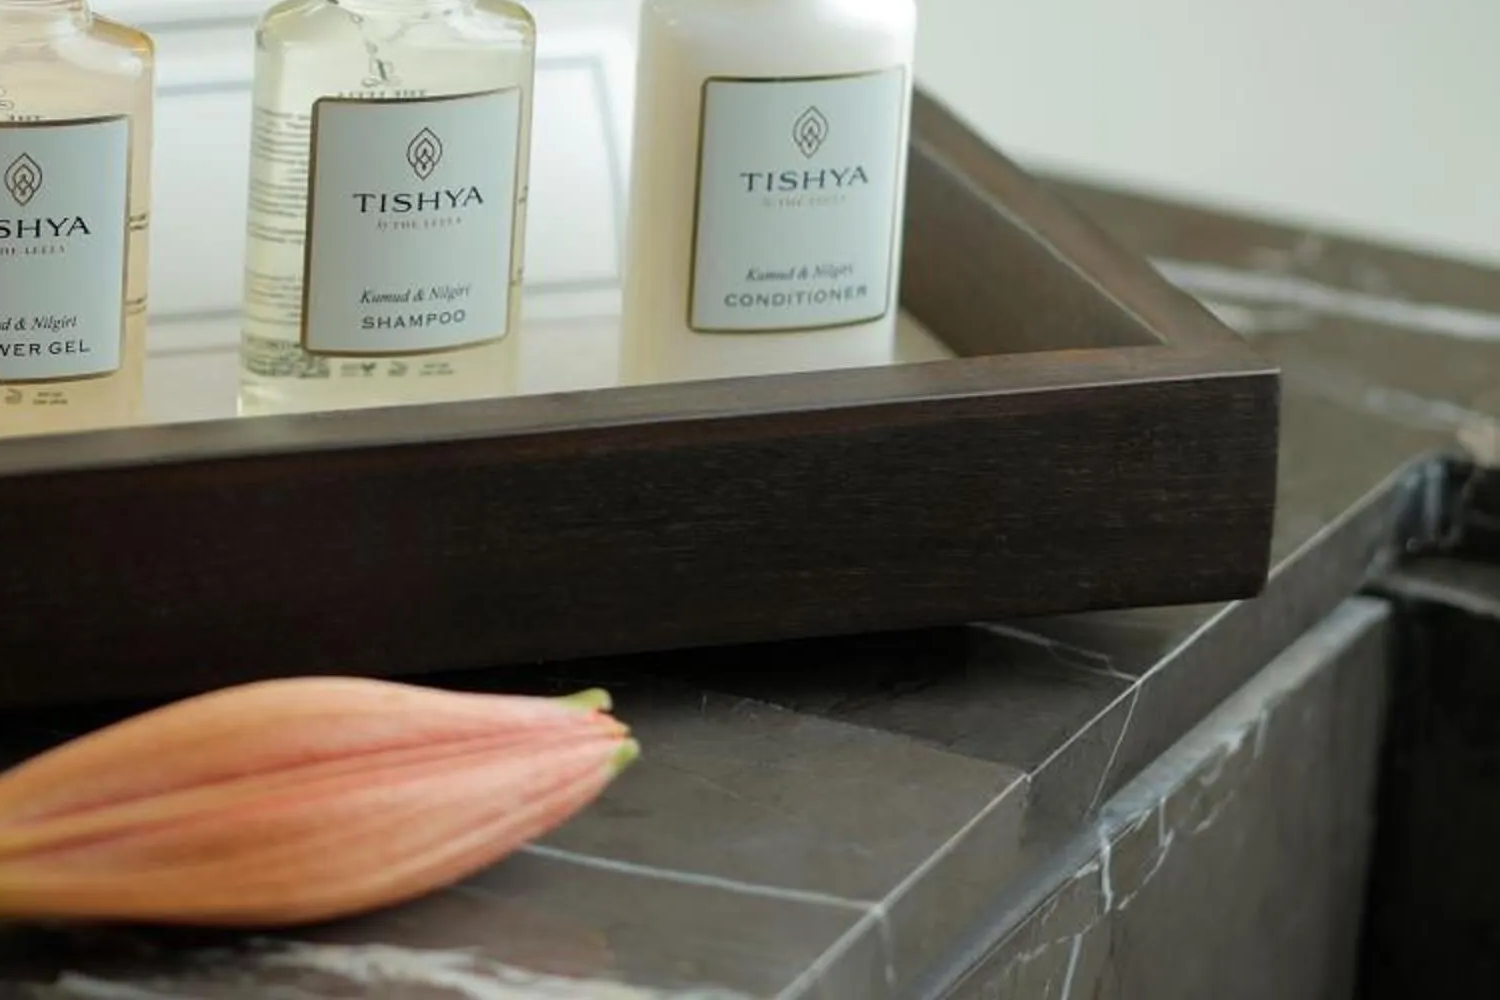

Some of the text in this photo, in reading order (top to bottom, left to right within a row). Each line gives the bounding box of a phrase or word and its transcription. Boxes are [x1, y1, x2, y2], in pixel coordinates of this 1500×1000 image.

[739, 166, 868, 193] TISHYA
[353, 185, 484, 213] TISHYA
[360, 283, 471, 304] Kumud & Nilgiri
[724, 285, 867, 308] CONDITIONER
[14, 318, 27, 331] &
[31, 314, 77, 333] Nilgiri
[361, 309, 467, 330] SHAMPOO
[48, 339, 91, 355] GEL
